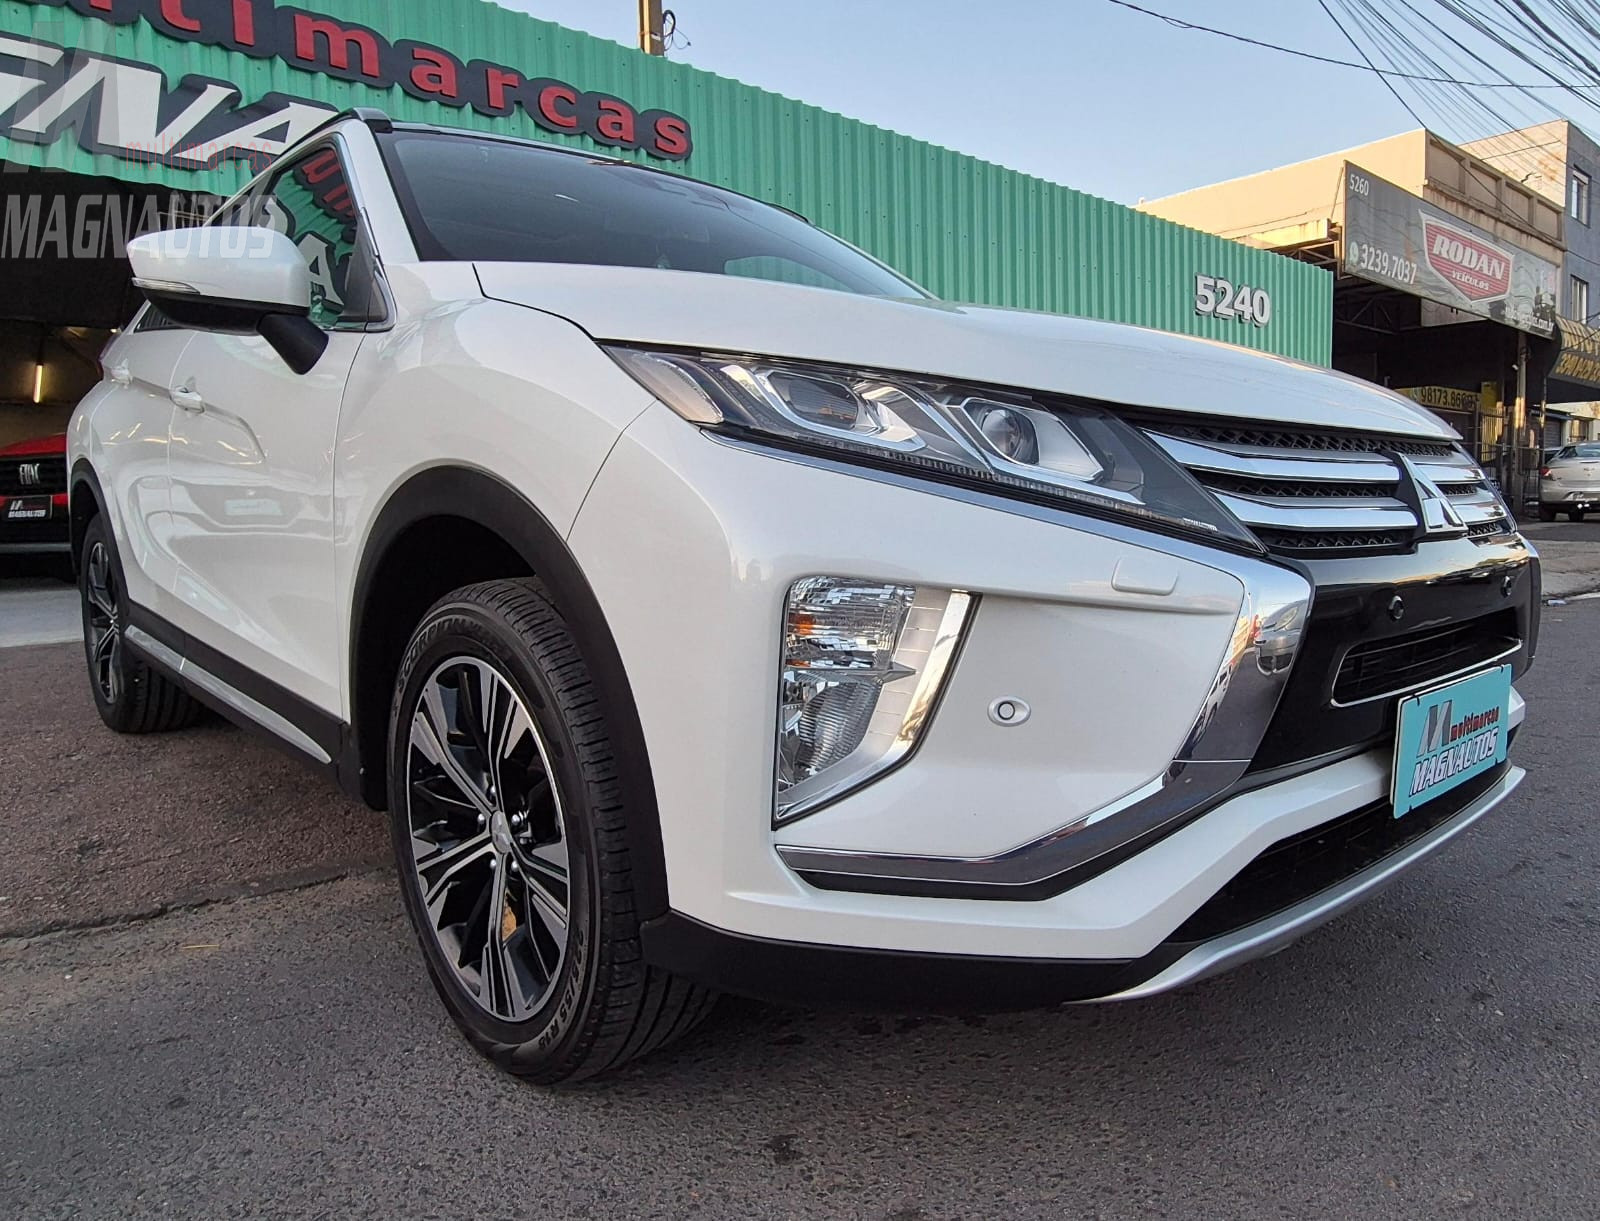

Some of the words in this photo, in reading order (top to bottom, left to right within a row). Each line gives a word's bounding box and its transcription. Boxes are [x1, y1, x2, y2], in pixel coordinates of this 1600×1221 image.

[1349, 173, 1369, 196] 5260
[1361, 244, 1417, 284] 3239.7037
[1432, 234, 1505, 280] RODAN
[1194, 273, 1271, 327] 5240
[19, 463, 41, 485] FIAT
[1408, 726, 1500, 798] MAGNAUTOS
